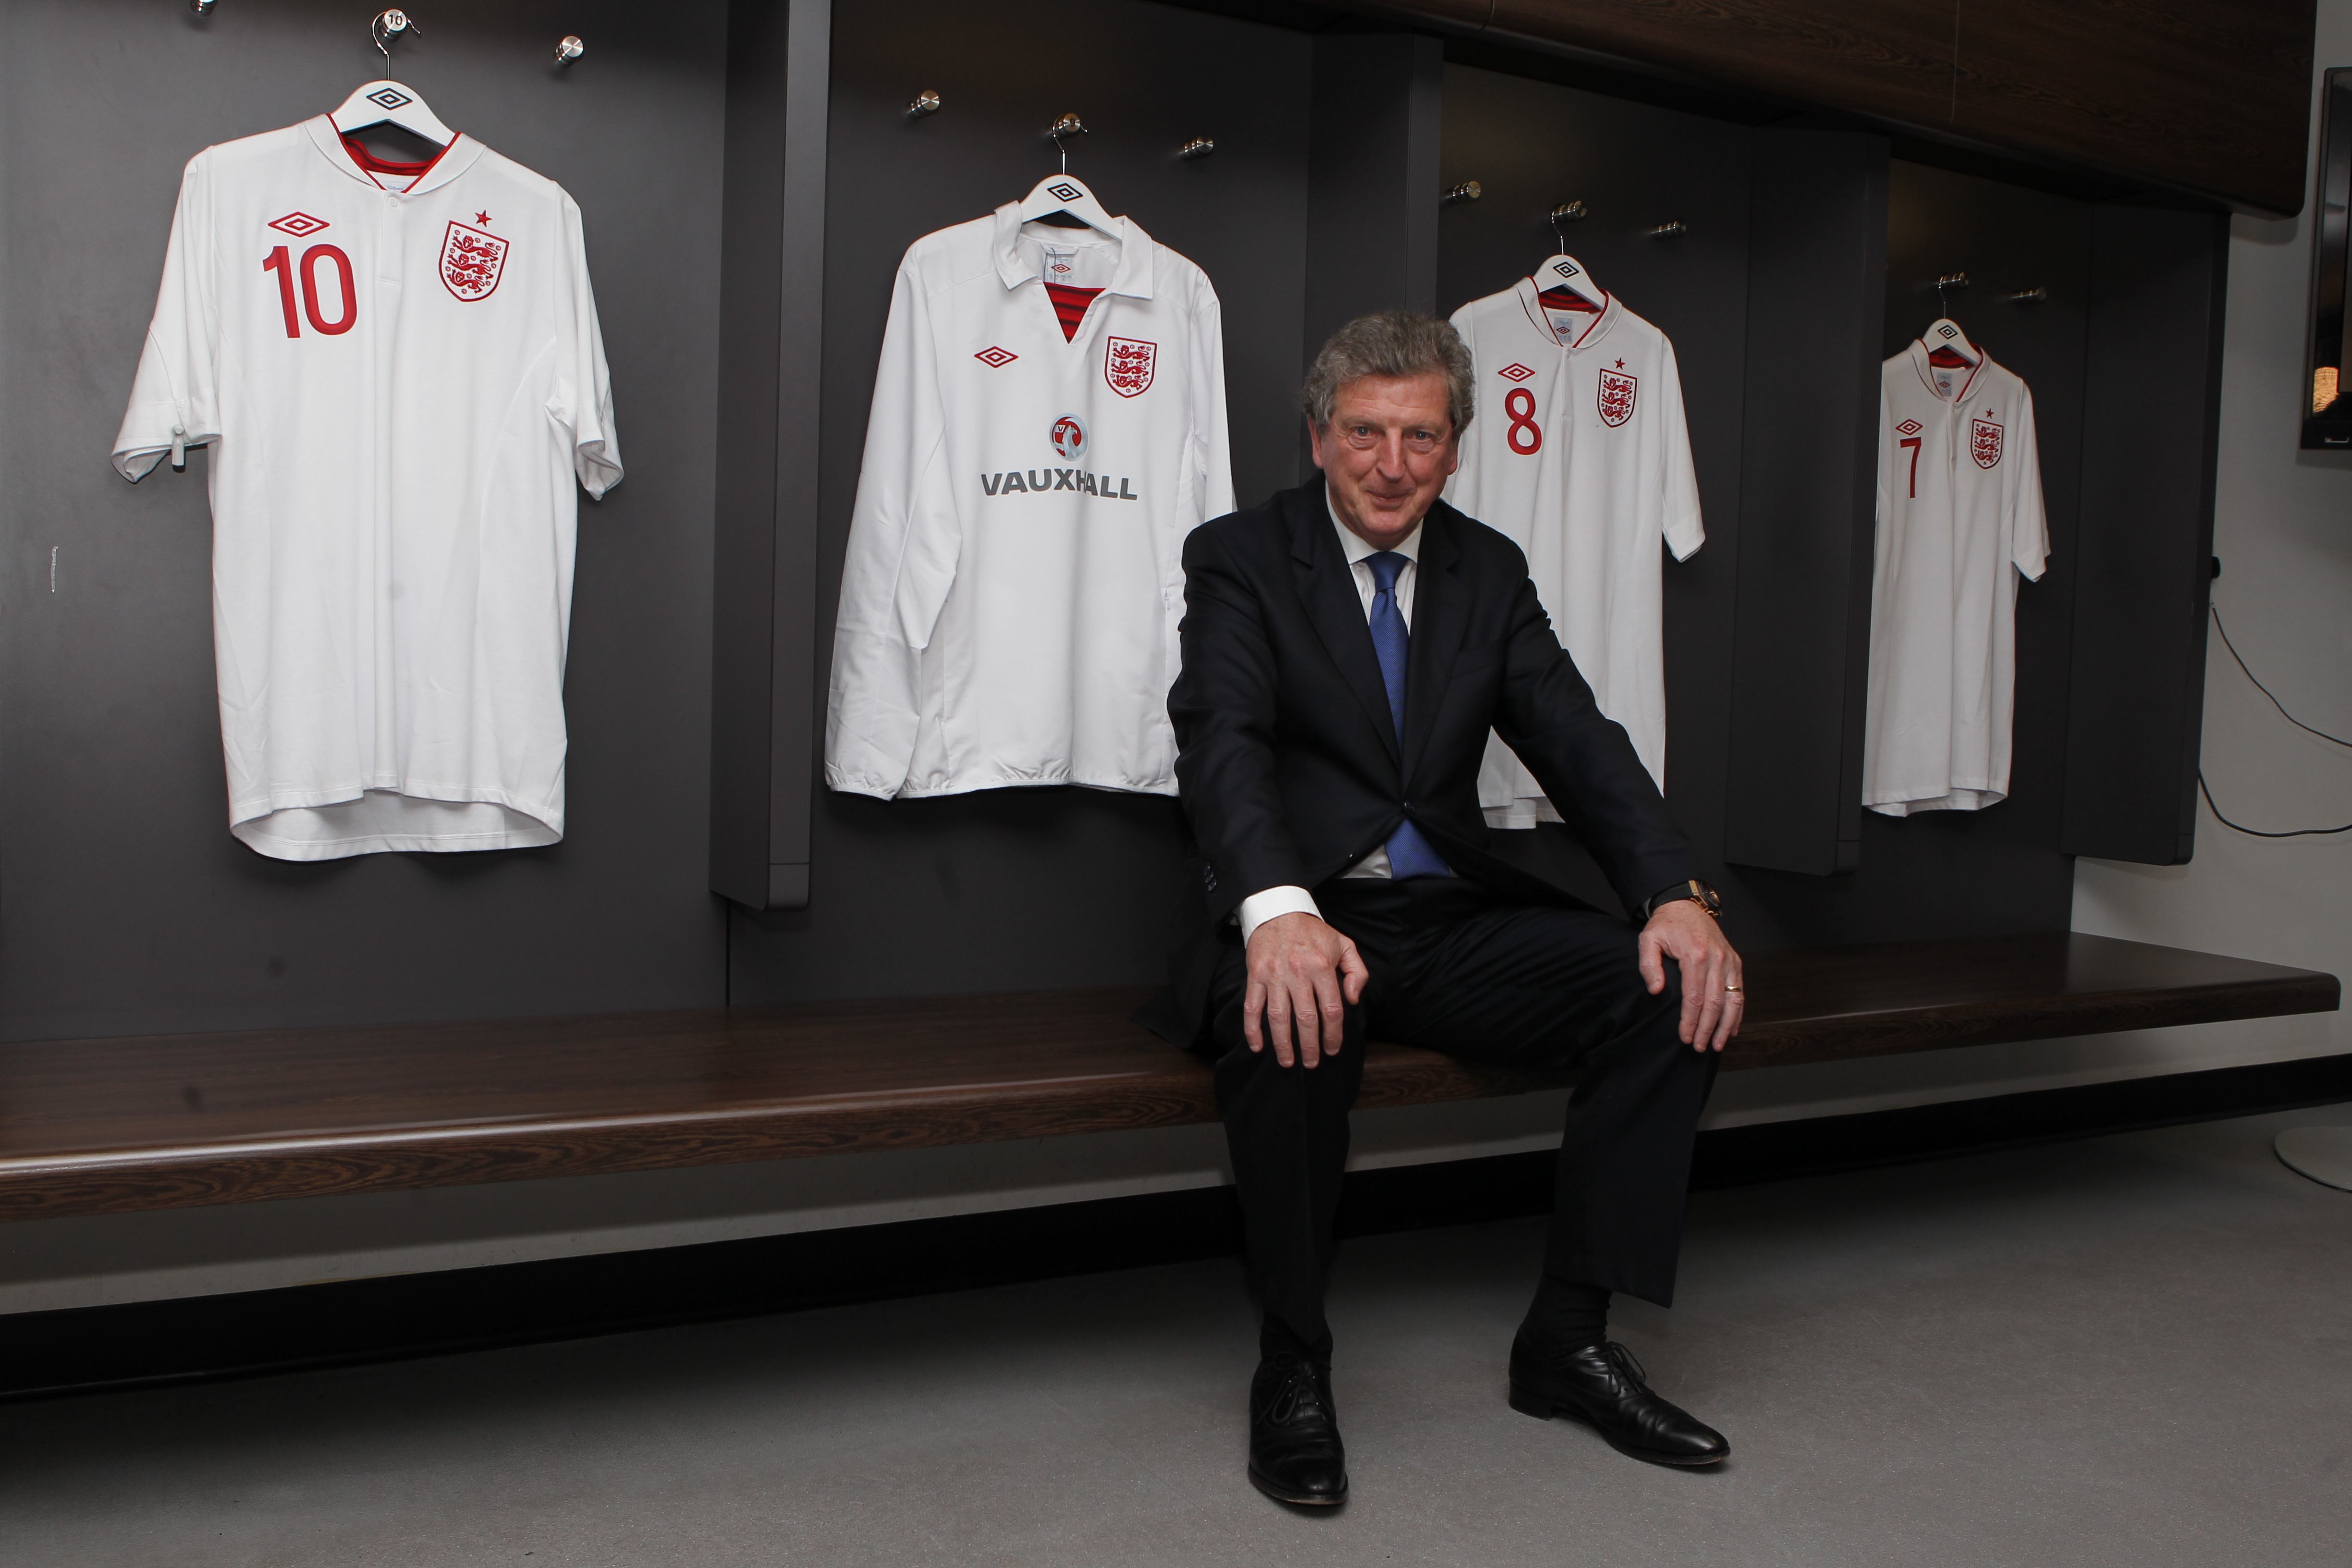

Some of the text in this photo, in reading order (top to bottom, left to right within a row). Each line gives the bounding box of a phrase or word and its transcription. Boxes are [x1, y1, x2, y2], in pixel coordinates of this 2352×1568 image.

[388, 14, 403, 26] 10
[1070, 118, 1075, 127] 9
[262, 244, 357, 338] 10
[1505, 388, 1542, 455] 8
[981, 469, 1138, 500] VAUXHALL
[1900, 436, 1922, 498] 7
